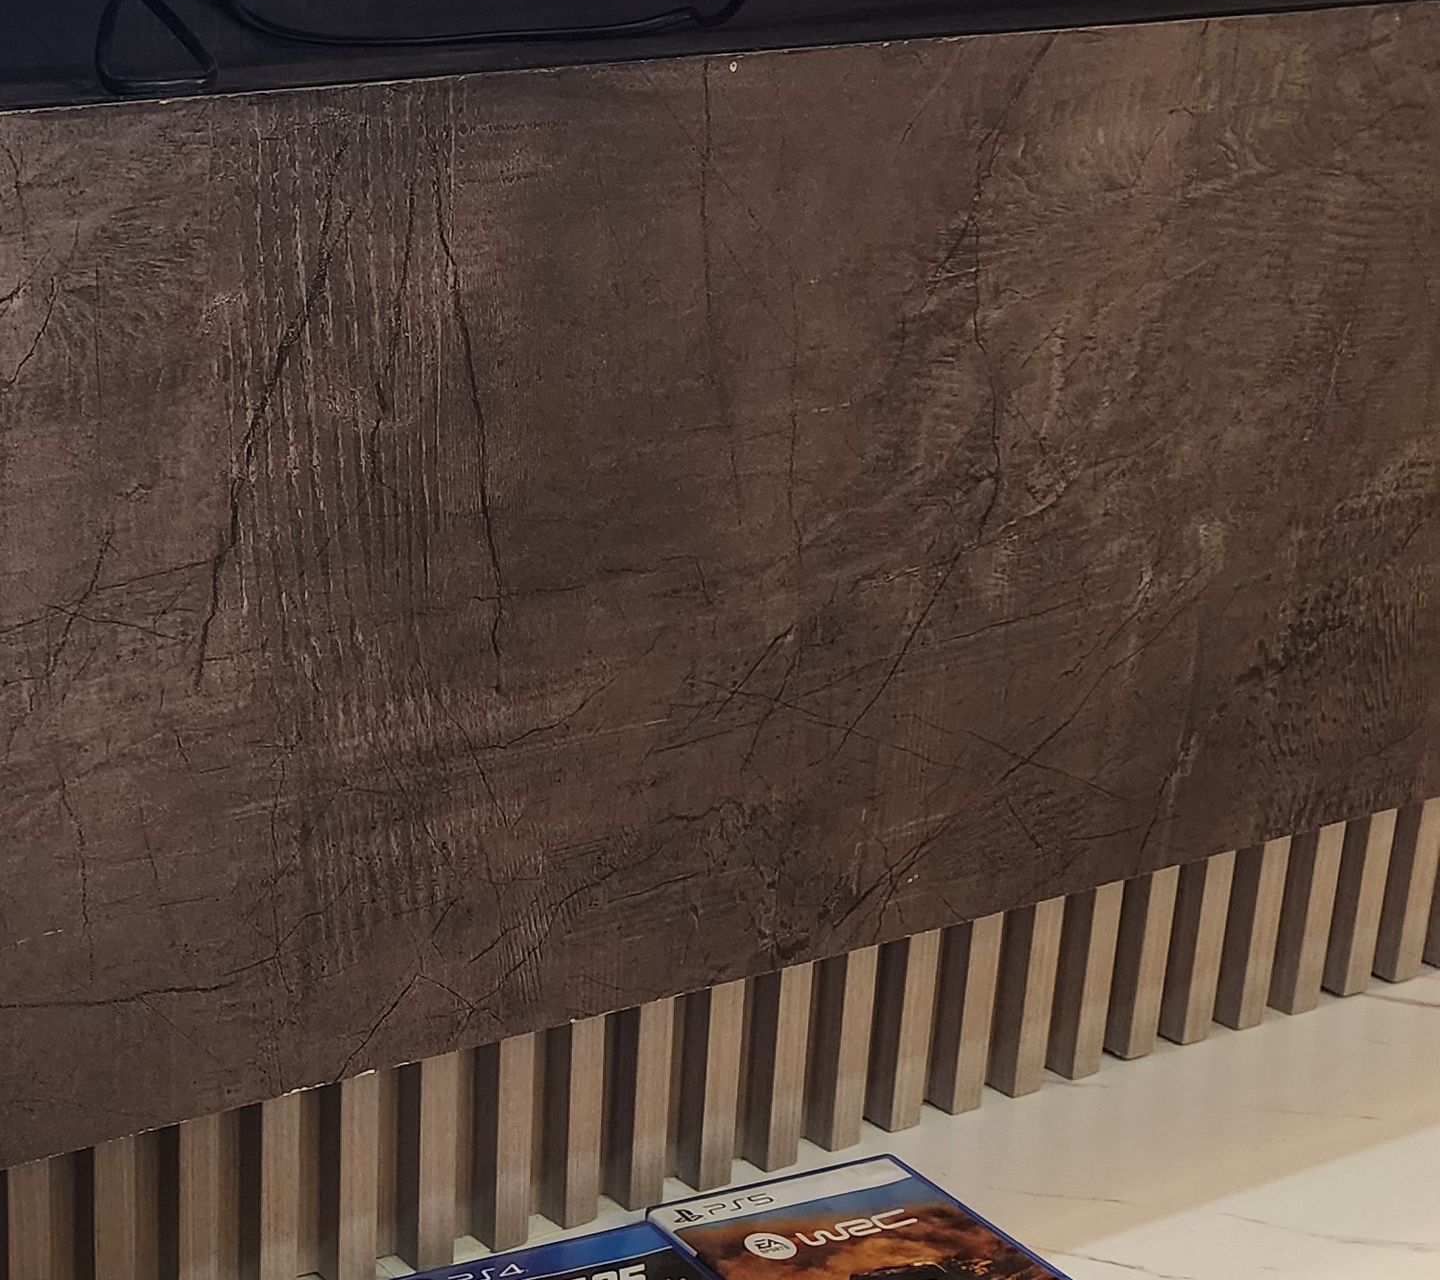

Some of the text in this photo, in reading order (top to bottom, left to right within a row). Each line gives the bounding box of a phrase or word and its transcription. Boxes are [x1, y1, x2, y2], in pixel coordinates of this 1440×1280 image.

[702, 1193, 775, 1216] PS5
[795, 1209, 918, 1247] WRC
[754, 1238, 791, 1250] EA
